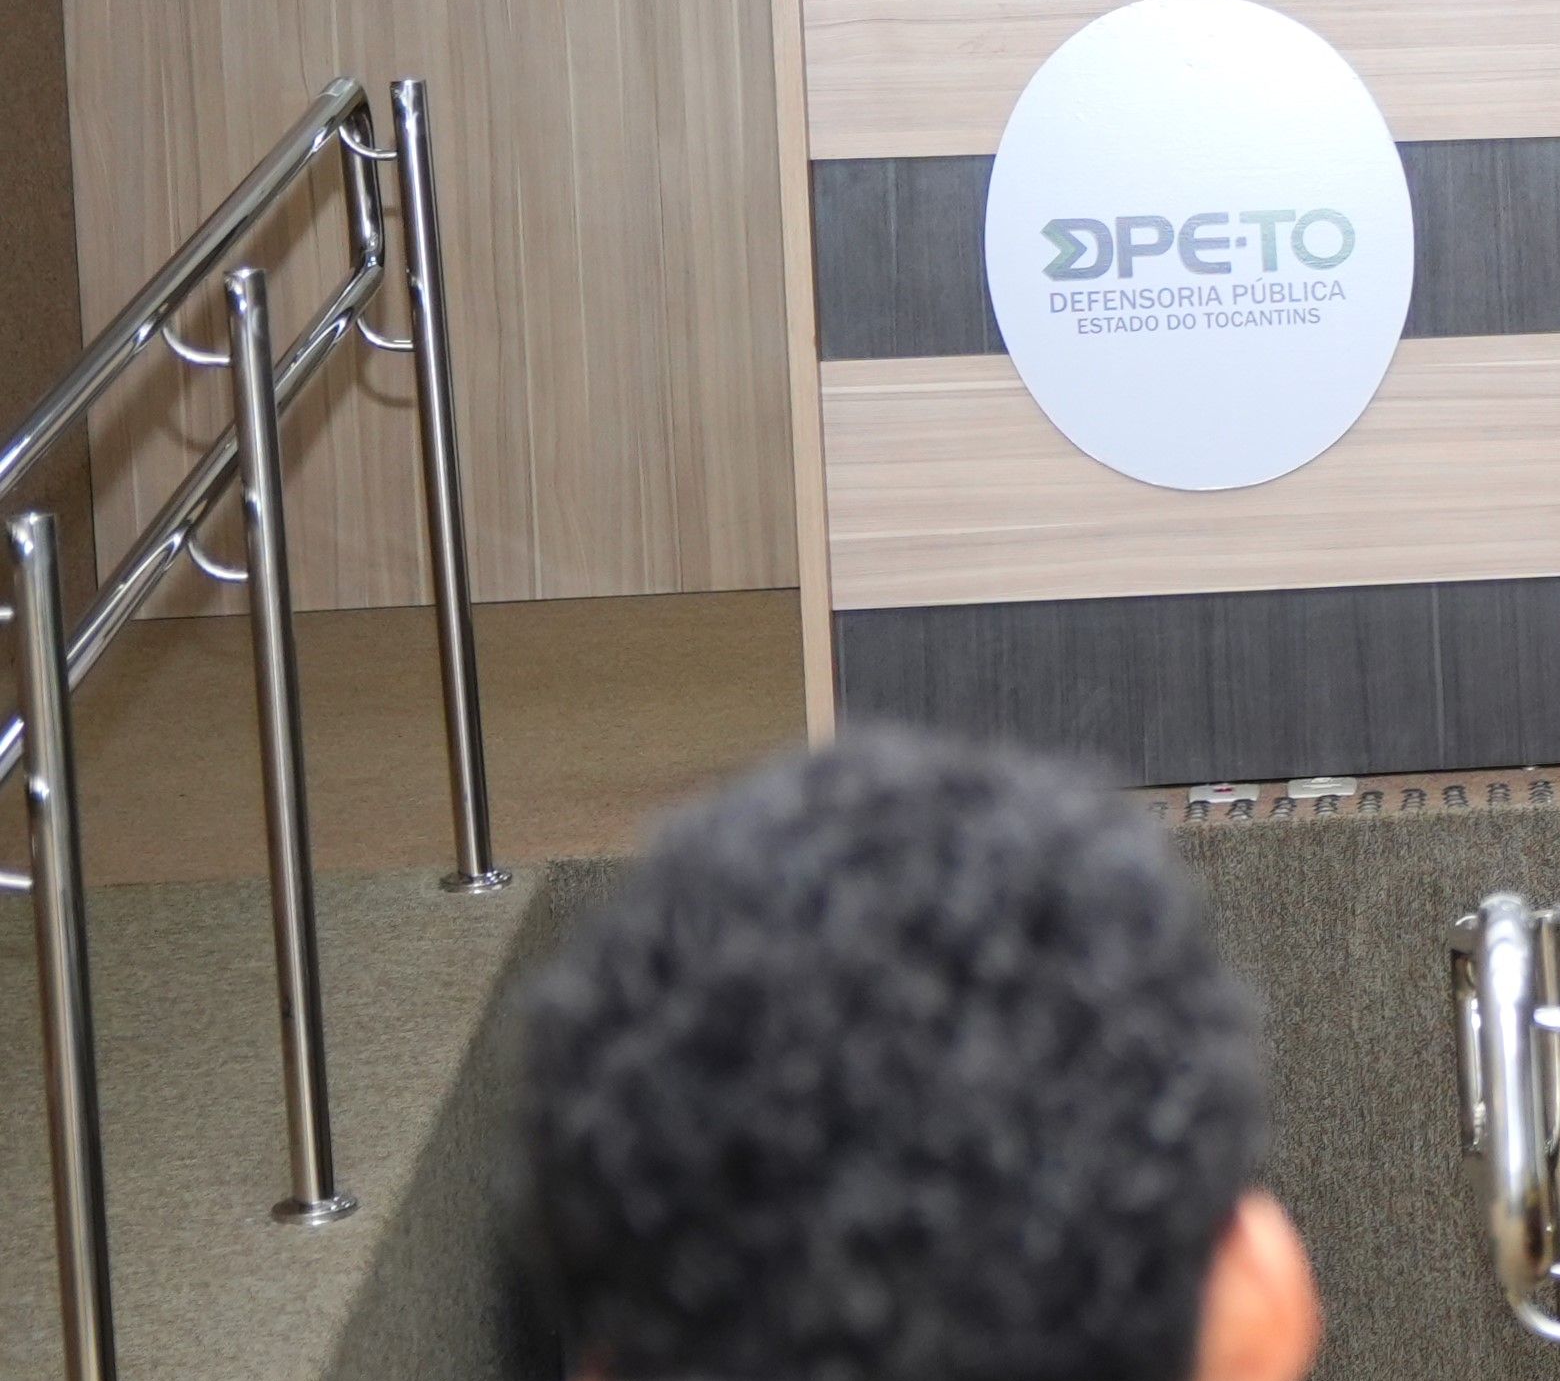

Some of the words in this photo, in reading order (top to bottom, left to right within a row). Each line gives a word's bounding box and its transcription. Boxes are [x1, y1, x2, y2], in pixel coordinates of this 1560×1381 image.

[1049, 285, 1223, 314] DEFENSORIA
[1232, 277, 1347, 305] PÚBLICA
[1078, 315, 1159, 335] ESTADO
[1167, 313, 1197, 331] DO
[1206, 307, 1321, 329] TOCANTINS
